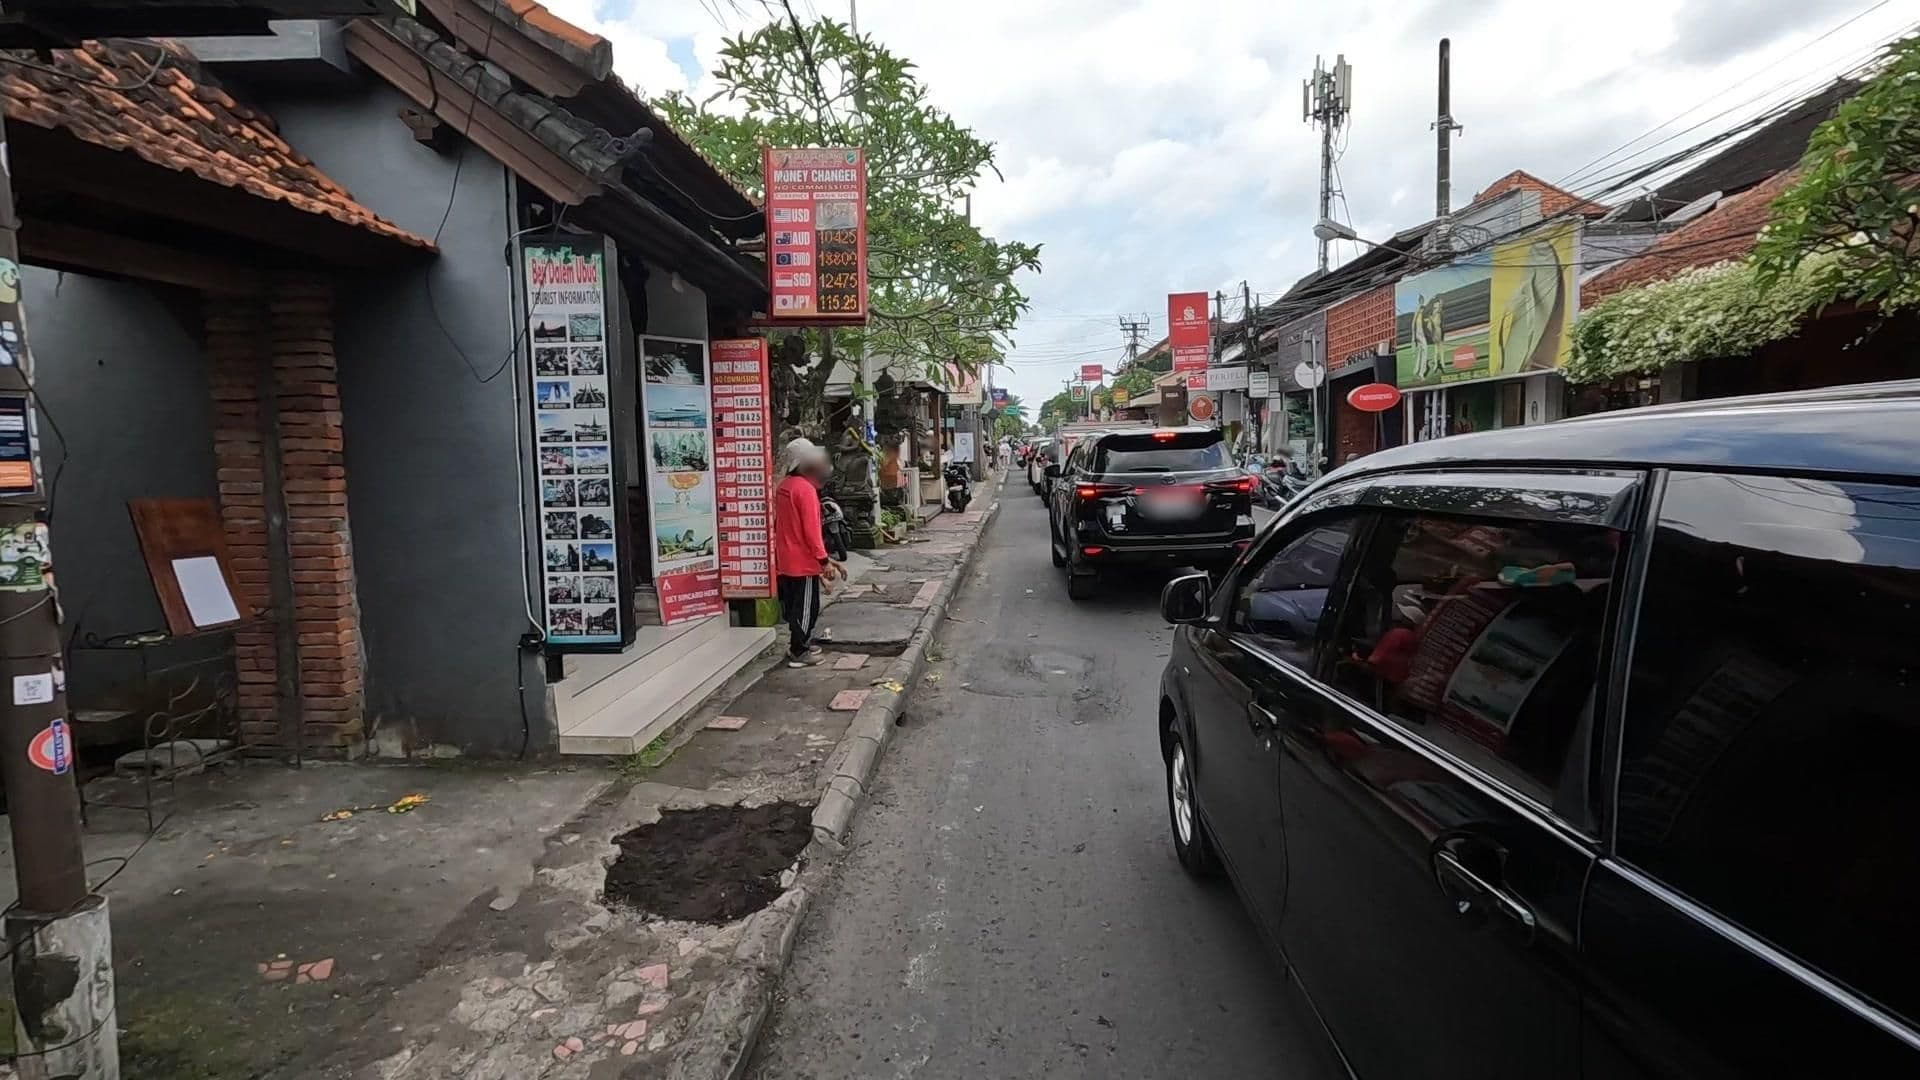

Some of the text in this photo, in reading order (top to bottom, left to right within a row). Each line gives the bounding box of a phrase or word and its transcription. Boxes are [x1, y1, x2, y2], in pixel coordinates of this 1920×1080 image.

[774, 168, 857, 183] MONEY CHANGER
[792, 208, 810, 223] USD
[792, 230, 857, 245] AUD 10425
[792, 252, 811, 266] EURO
[576, 255, 598, 284] Ubud
[793, 273, 858, 288] SGD 12475
[531, 290, 601, 305] TOURIST INFORMATION
[793, 295, 857, 310] JPY 115.25
[714, 375, 760, 384] NO COMMISSION
[752, 561, 768, 570] 375
[753, 576, 769, 585] 150
[665, 595, 678, 604] GET
[704, 588, 719, 598] HERE
